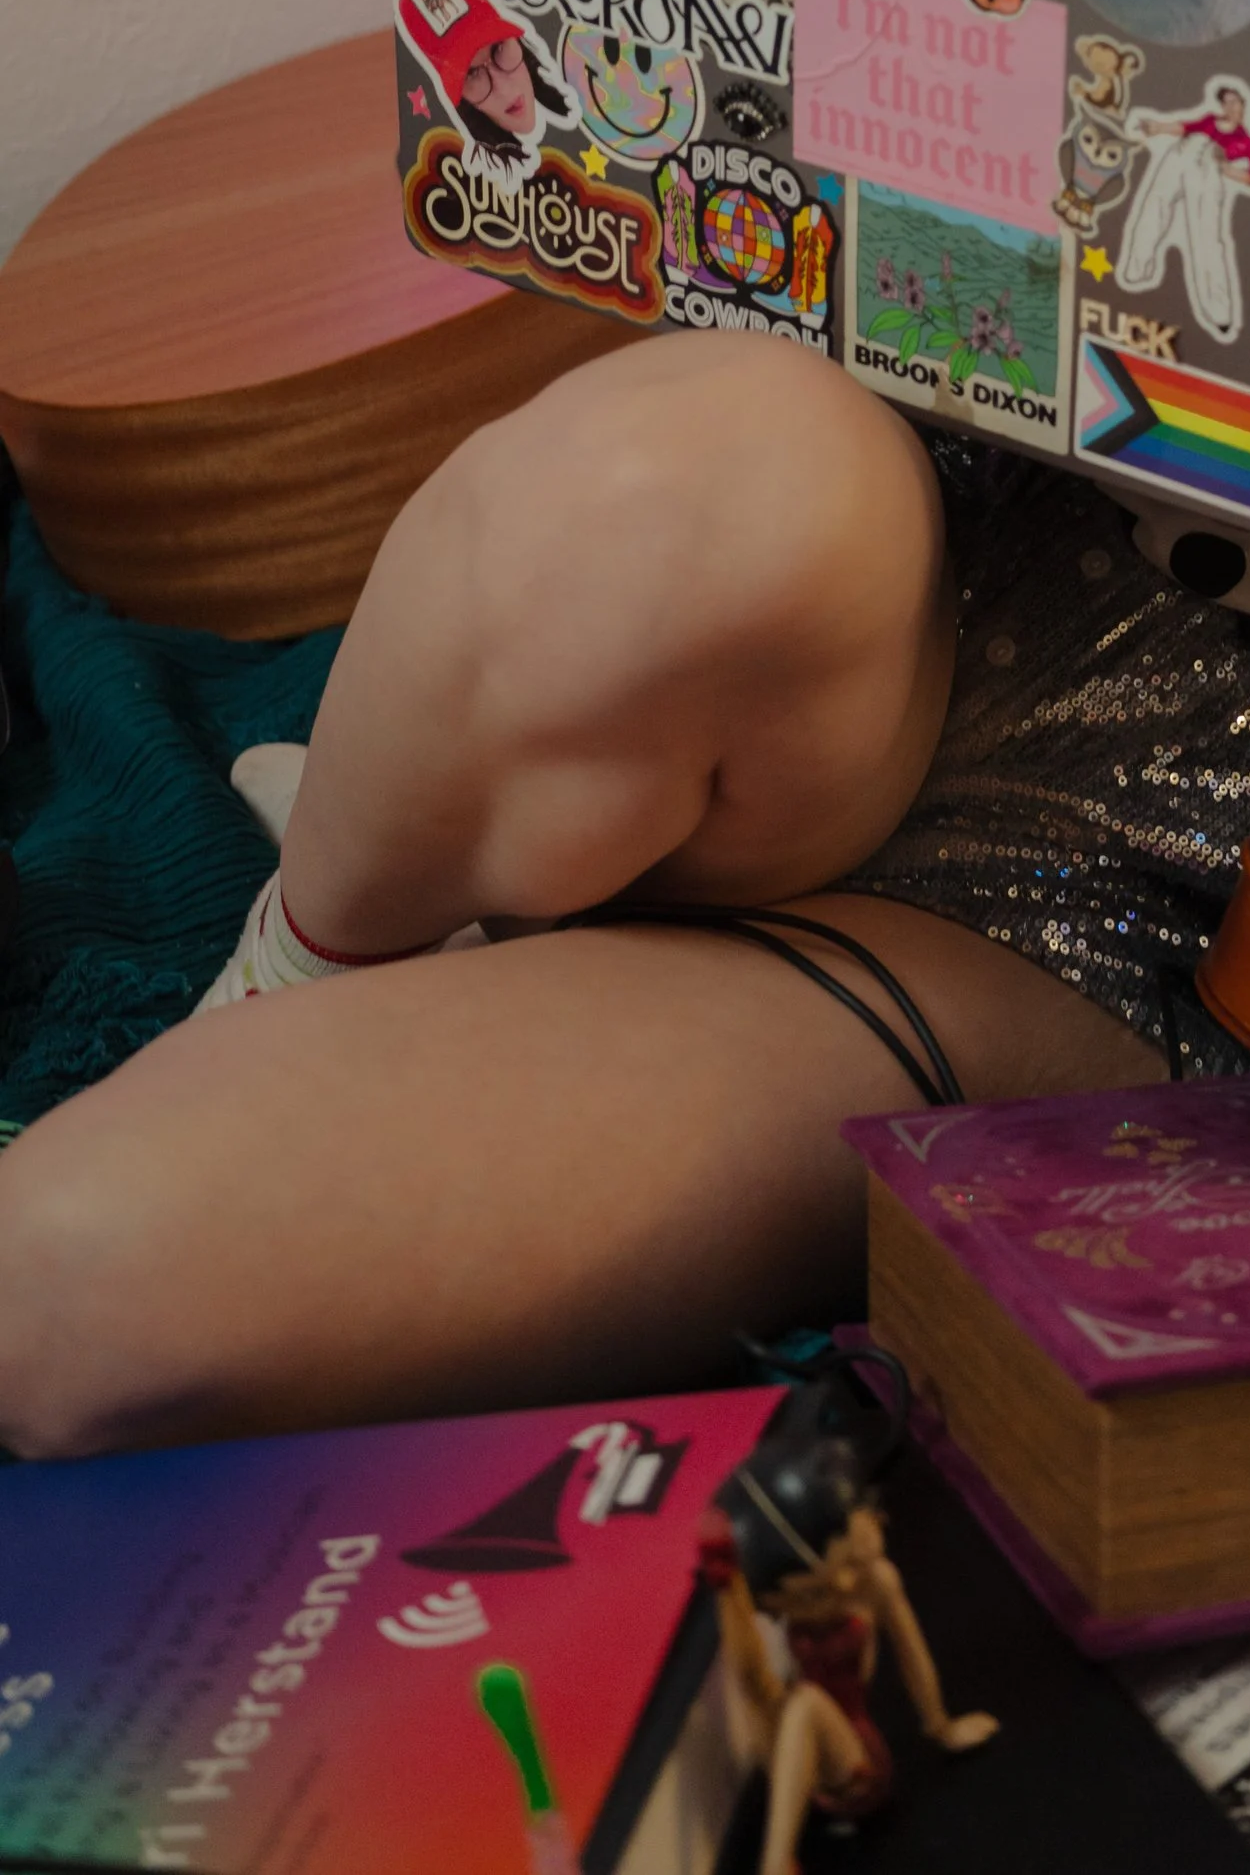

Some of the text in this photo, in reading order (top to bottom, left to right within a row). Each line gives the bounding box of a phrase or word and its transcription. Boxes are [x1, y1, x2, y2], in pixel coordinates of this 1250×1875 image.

[922, 10, 1016, 78] not
[867, 53, 984, 136] that
[692, 145, 801, 208] DISCO
[807, 83, 1040, 207] innocent
[1080, 298, 1178, 363] FUCK
[972, 382, 1057, 428] DIXON
[165, 1533, 382, 1803] Herstand
